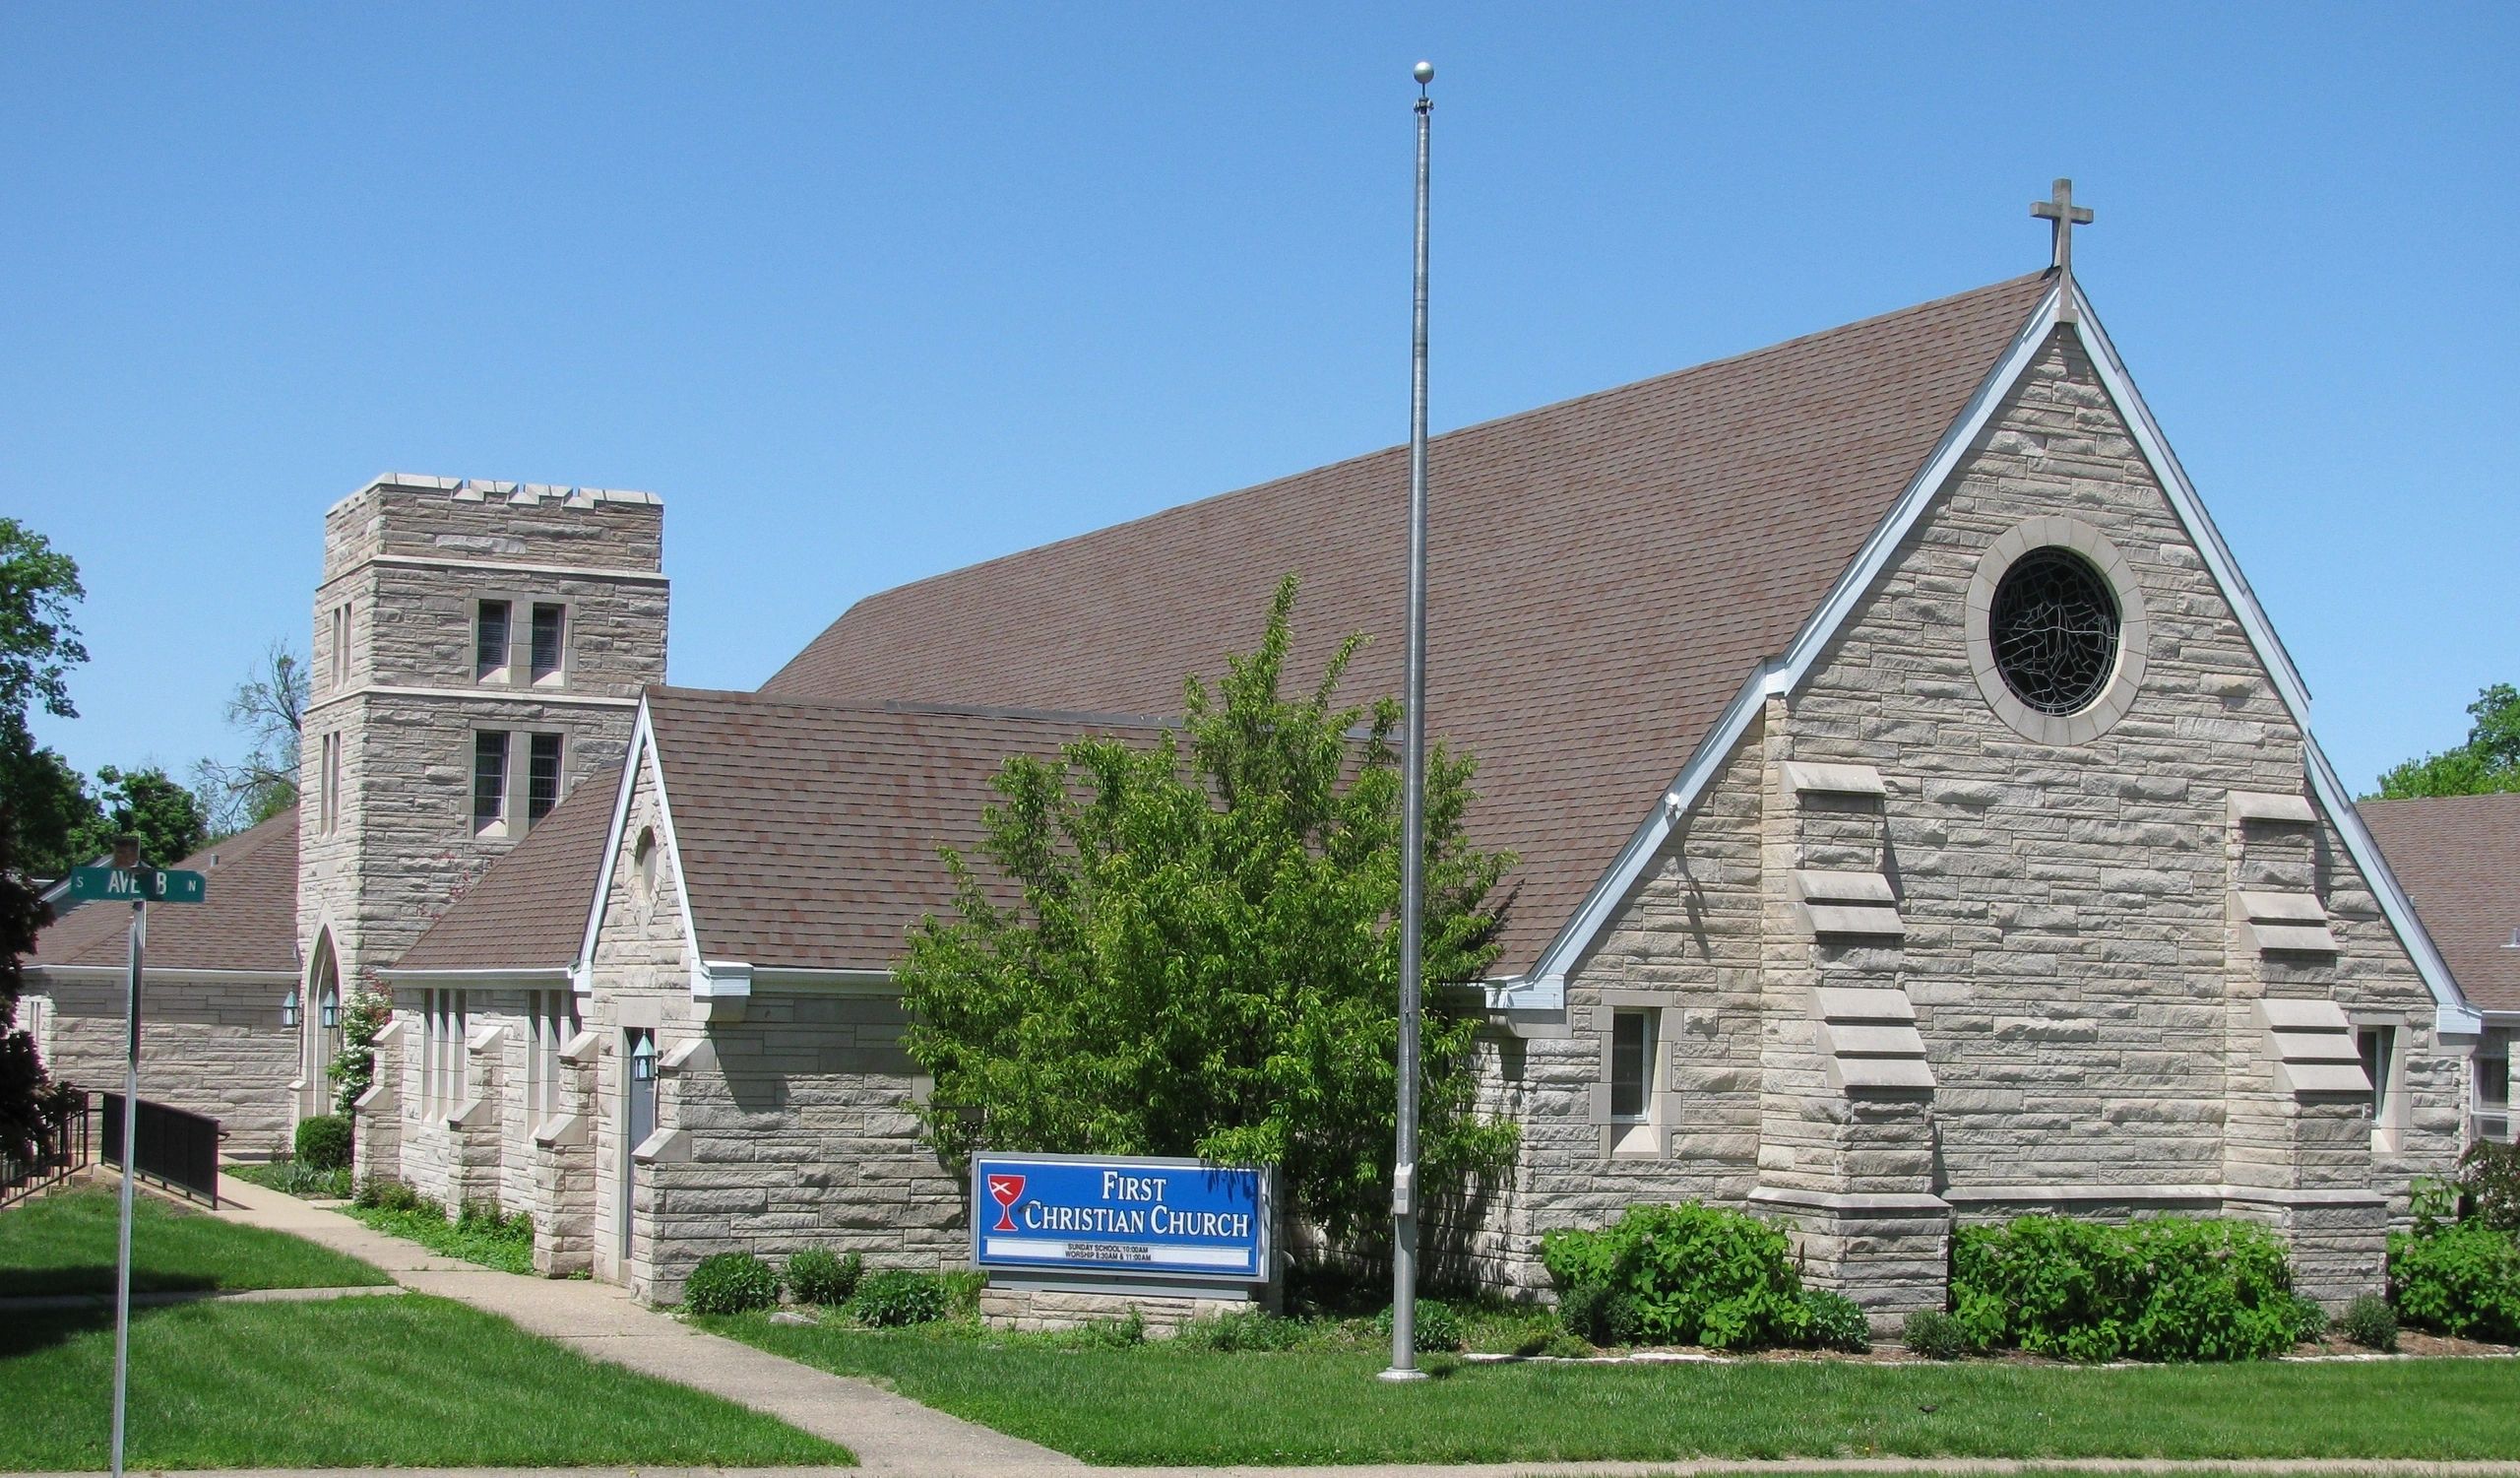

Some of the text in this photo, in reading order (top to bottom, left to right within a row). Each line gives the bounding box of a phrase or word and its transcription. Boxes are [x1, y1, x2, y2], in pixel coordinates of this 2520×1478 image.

[77, 870, 197, 895] S AVE B N
[1151, 1204, 1248, 1238] CHURCH
